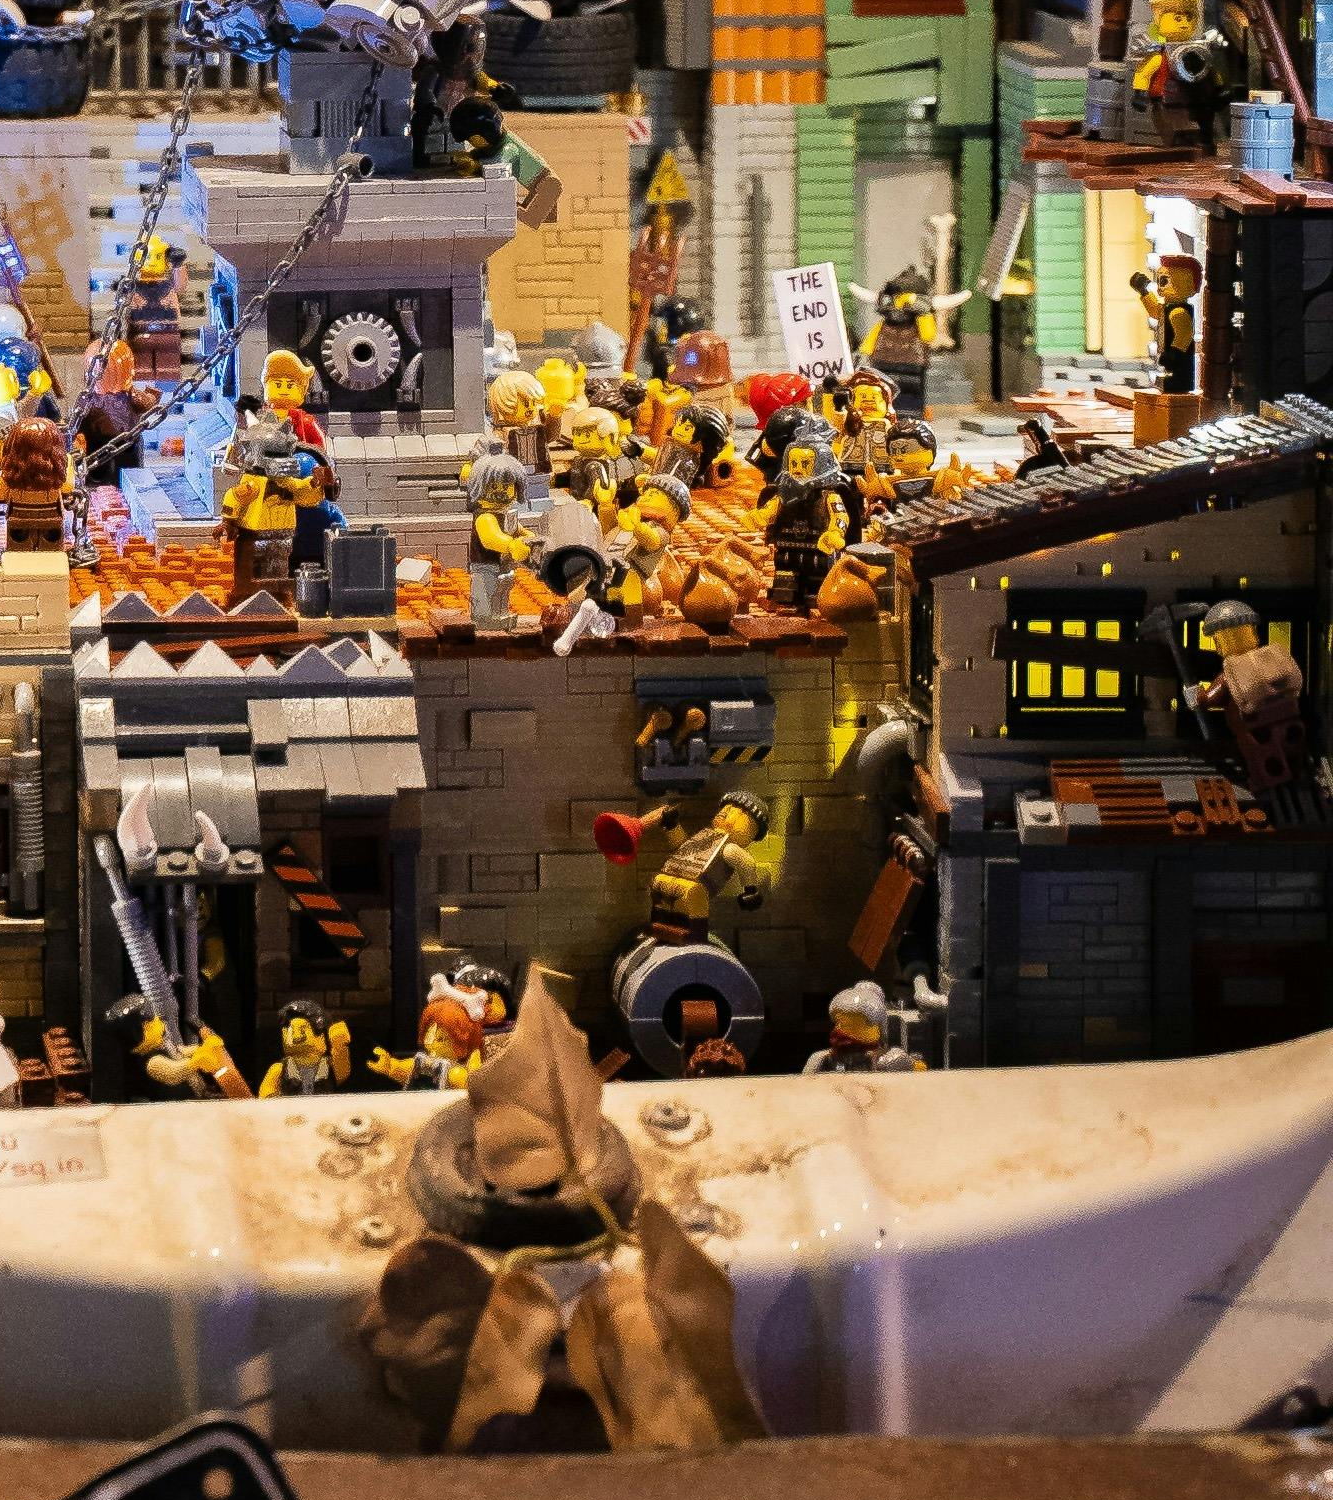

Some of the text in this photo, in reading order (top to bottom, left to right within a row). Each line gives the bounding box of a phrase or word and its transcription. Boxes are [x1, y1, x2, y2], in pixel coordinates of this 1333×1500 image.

[787, 271, 823, 292] THE
[792, 302, 828, 322] END
[808, 331, 824, 350] IS
[798, 358, 844, 379] NOW
